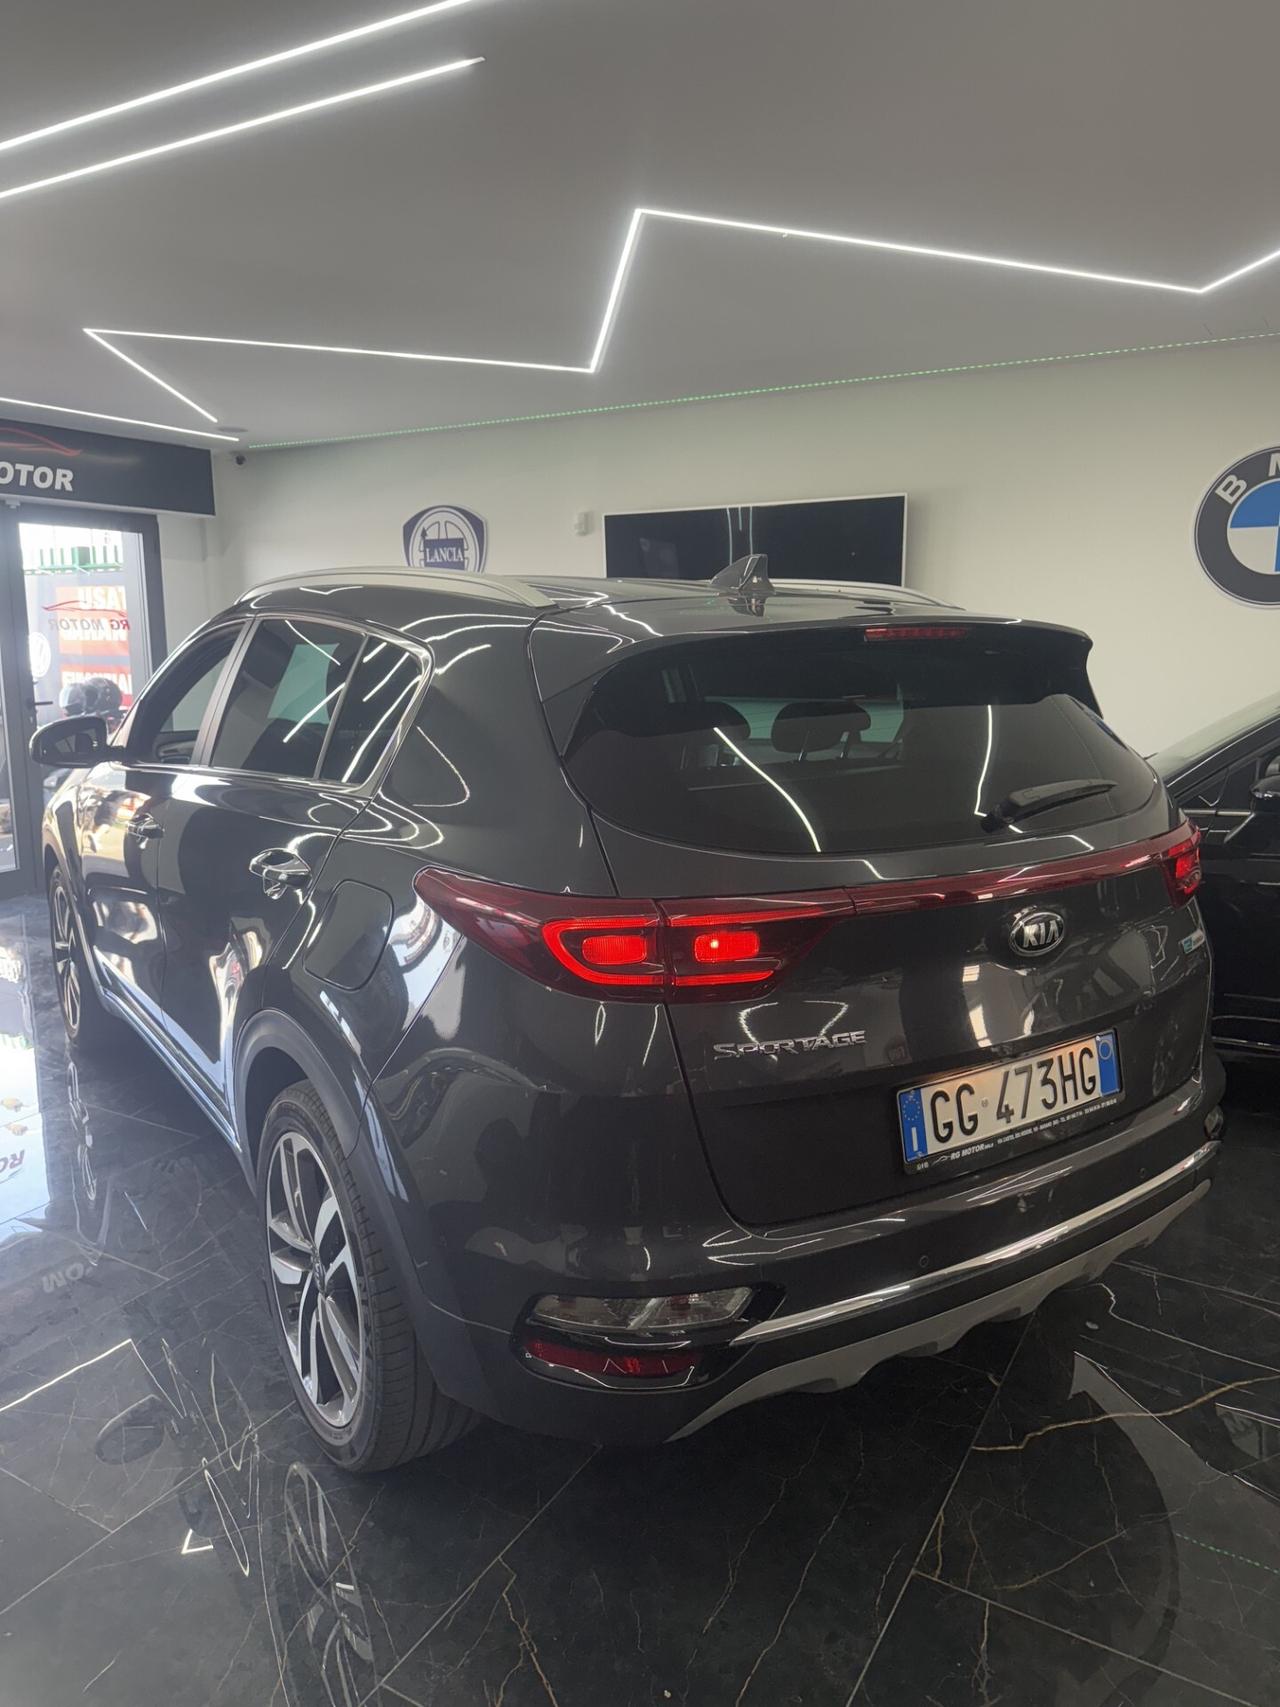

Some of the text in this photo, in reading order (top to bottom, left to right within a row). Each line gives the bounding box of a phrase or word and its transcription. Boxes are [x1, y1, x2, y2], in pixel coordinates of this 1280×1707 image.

[426, 546, 464, 563] LANCIA
[1023, 919, 1060, 948] KIA
[713, 1030, 867, 1060] SPORTAGE
[930, 1047, 1097, 1144] GG 473HG
[950, 1150, 961, 1160] RG
[961, 1143, 985, 1157] MOTOR
